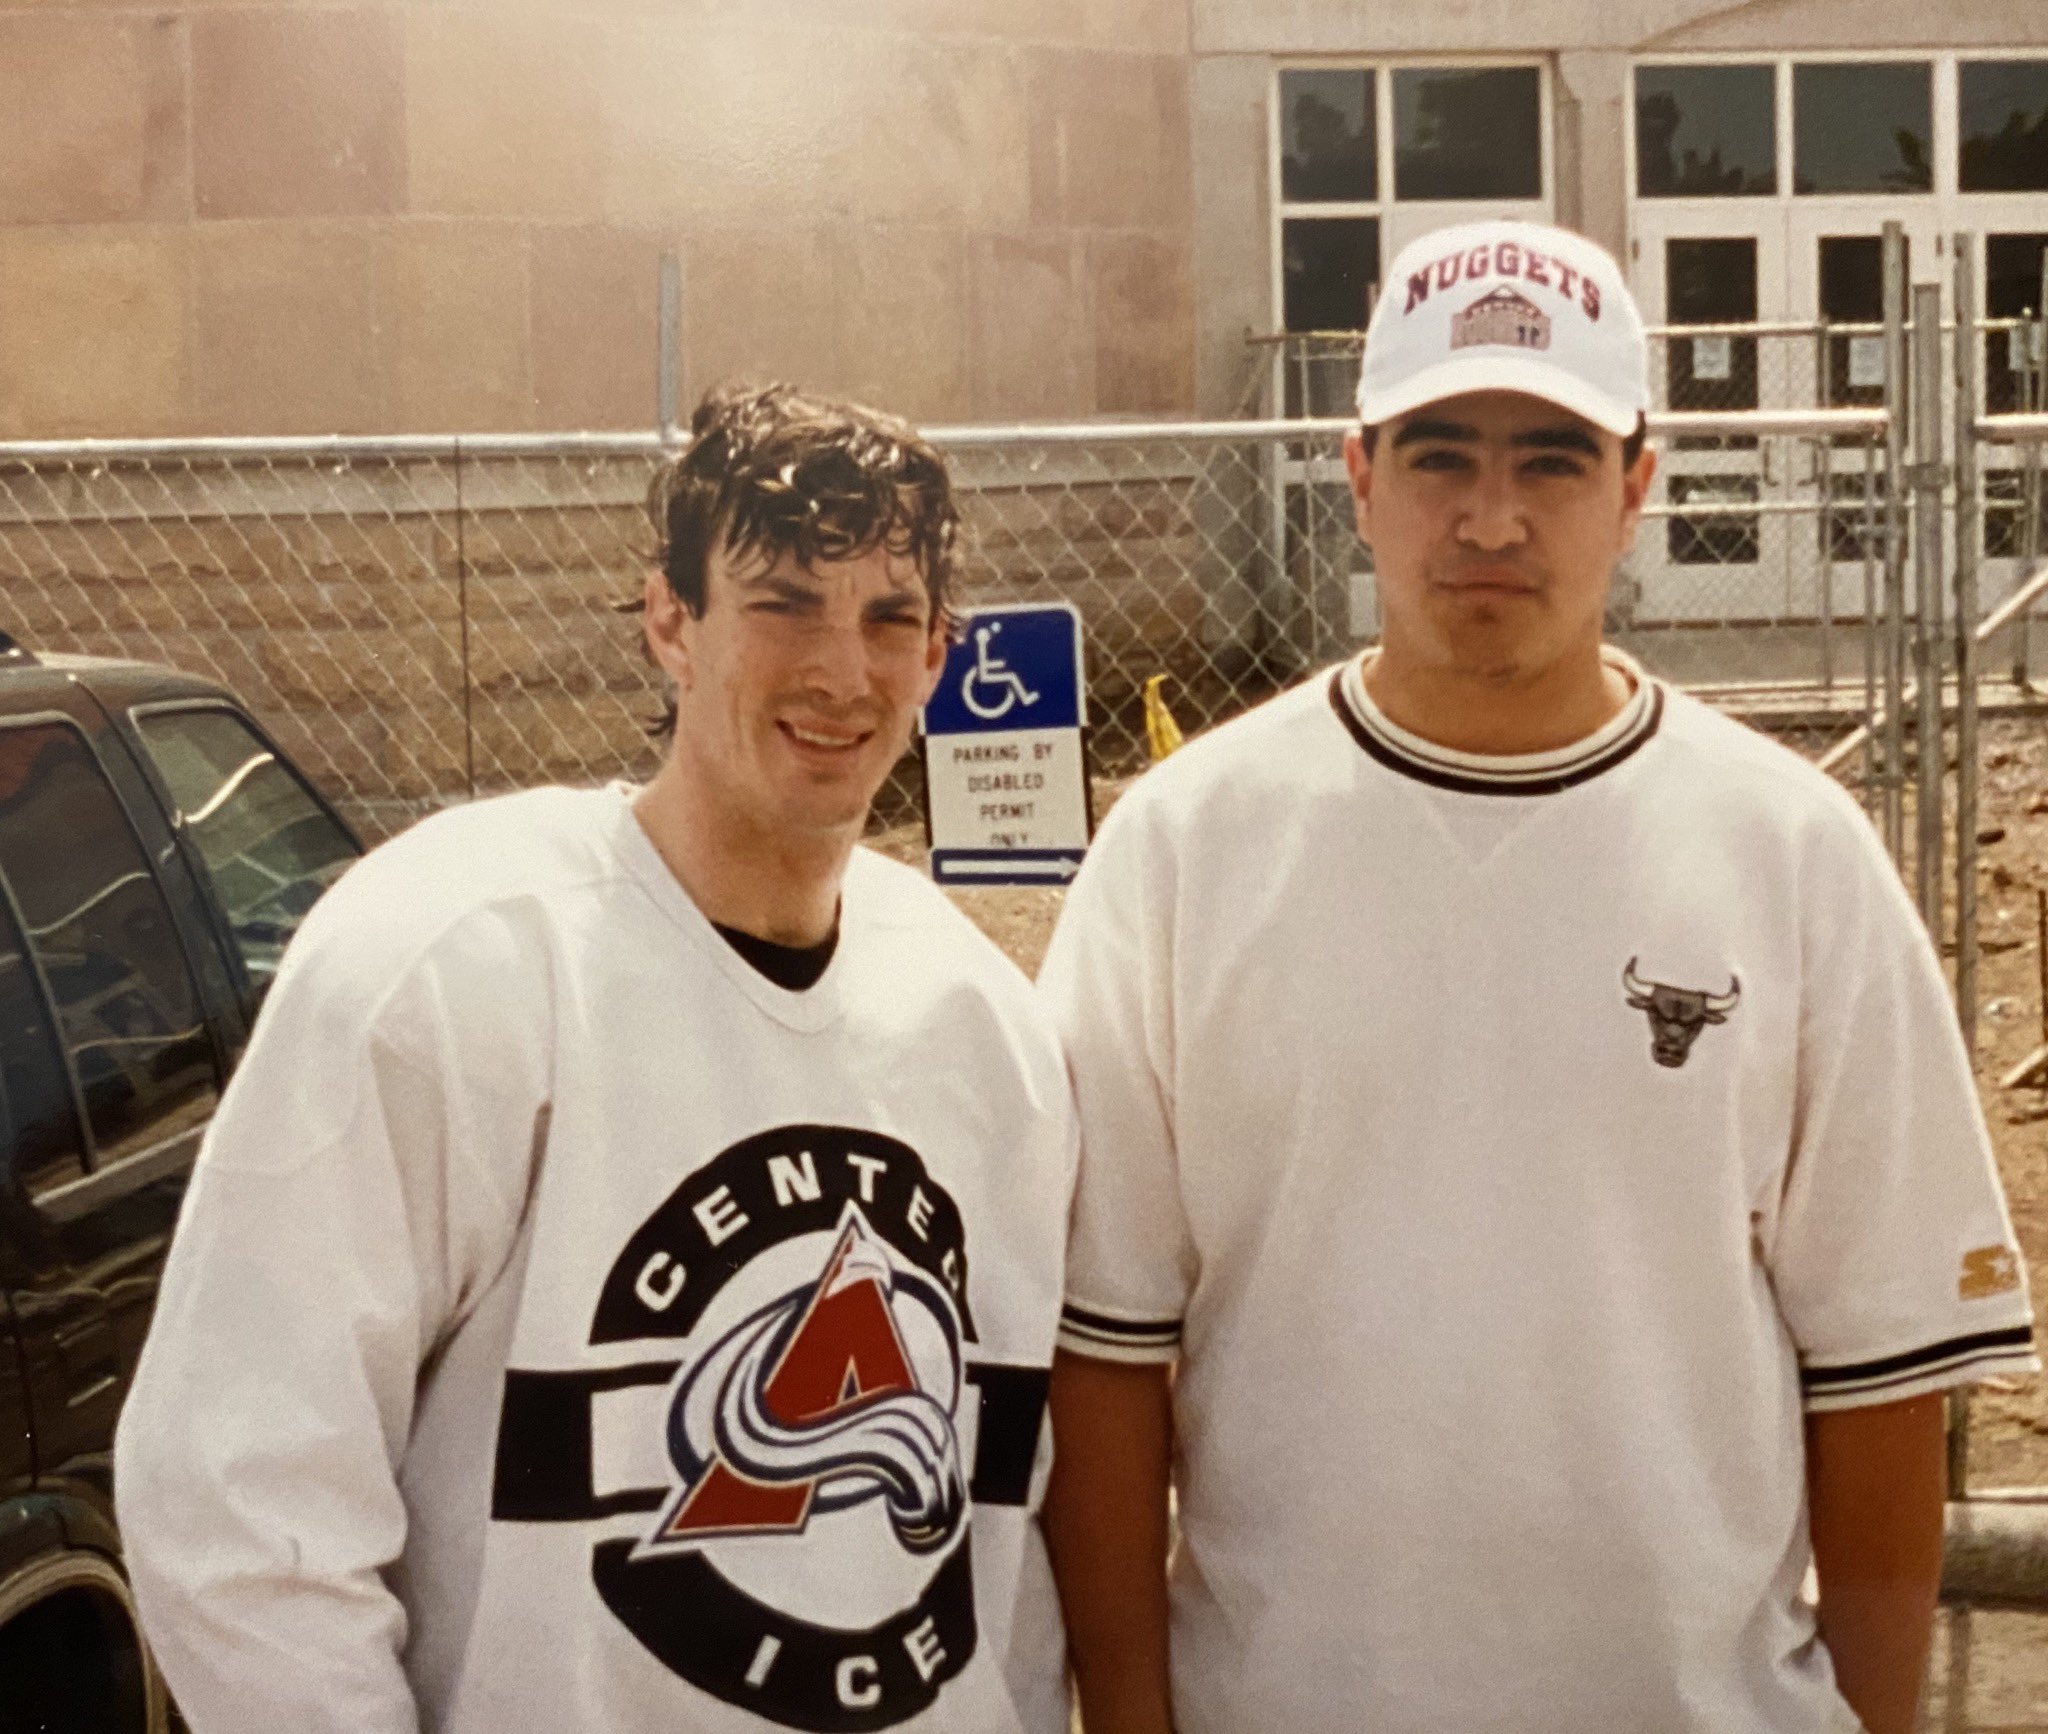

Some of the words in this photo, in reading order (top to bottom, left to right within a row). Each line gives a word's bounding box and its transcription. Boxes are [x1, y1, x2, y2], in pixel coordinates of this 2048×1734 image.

[1403, 242, 1600, 322] NUGGETS
[953, 745, 1019, 763] PARKING
[1033, 743, 1053, 760] BY
[968, 773, 1044, 792] DISABLED
[980, 802, 1033, 821] PERMIT
[990, 832, 1028, 847] ONY
[744, 1616, 947, 1708] ICE
